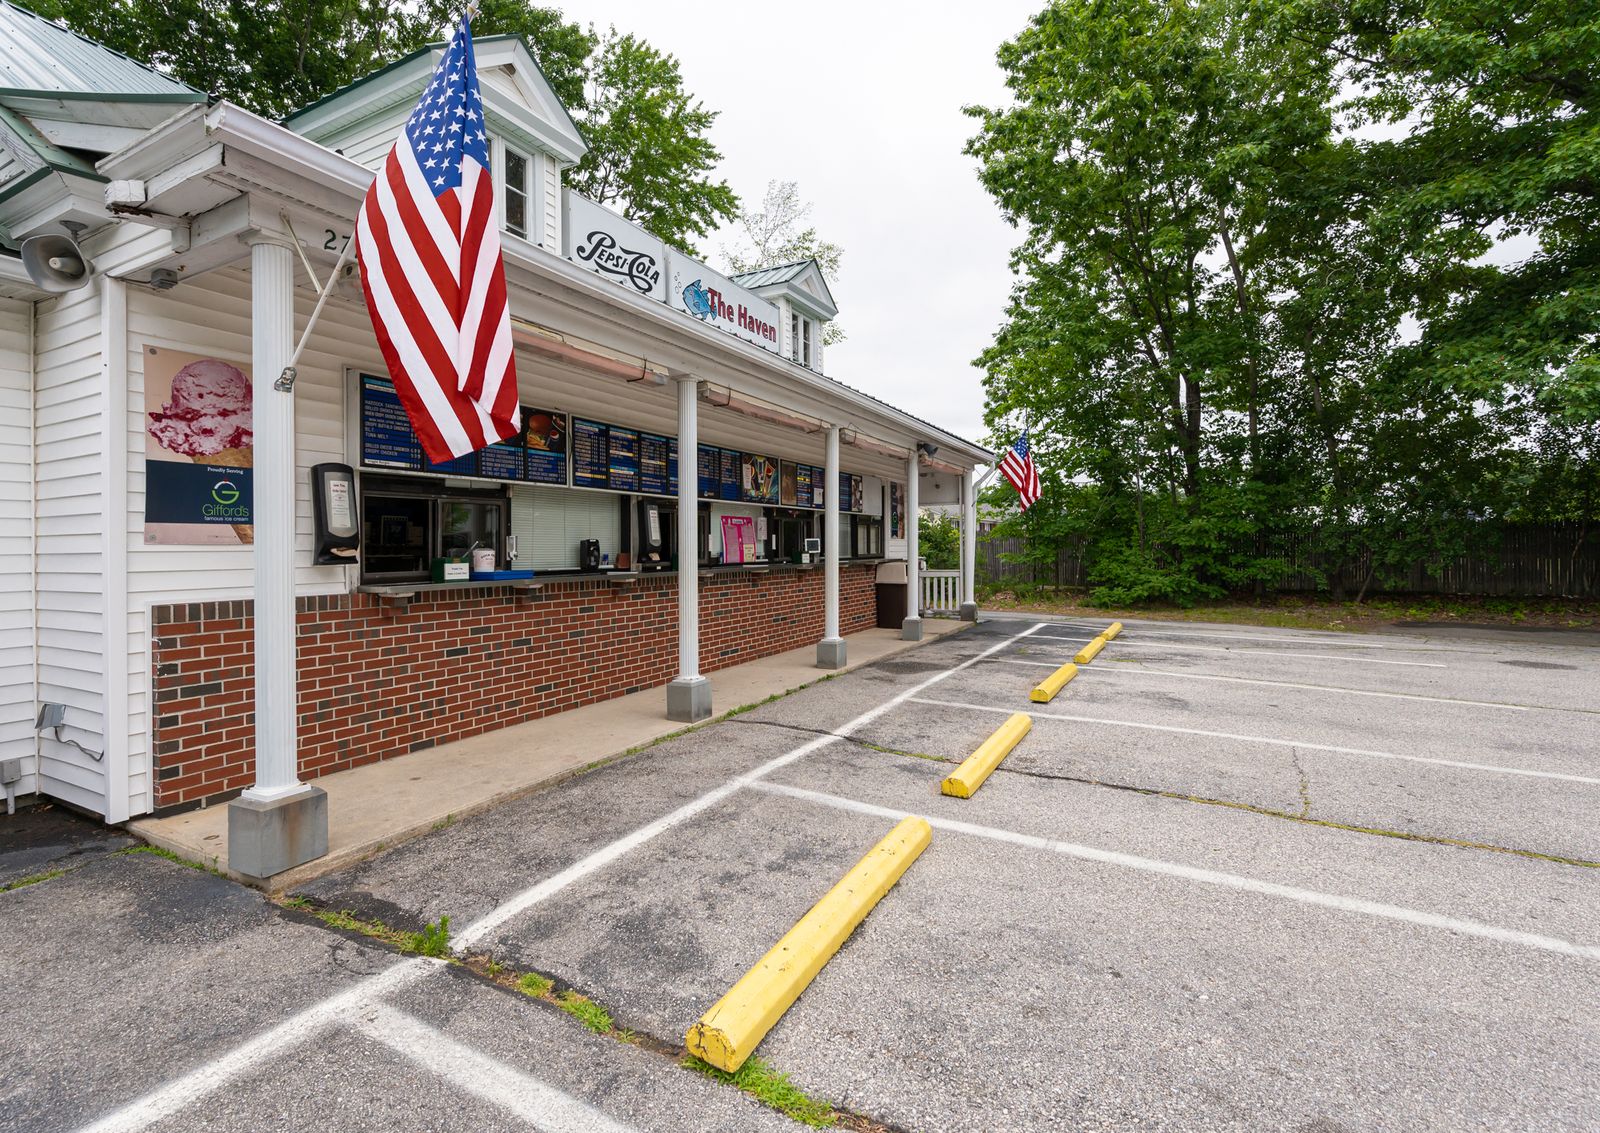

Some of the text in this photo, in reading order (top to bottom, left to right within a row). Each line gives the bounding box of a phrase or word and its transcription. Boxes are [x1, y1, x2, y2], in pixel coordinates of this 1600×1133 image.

[324, 229, 357, 258] 27
[707, 287, 777, 343] The Haven
[207, 466, 226, 474] Proudly
[202, 503, 250, 517] Gifford's
